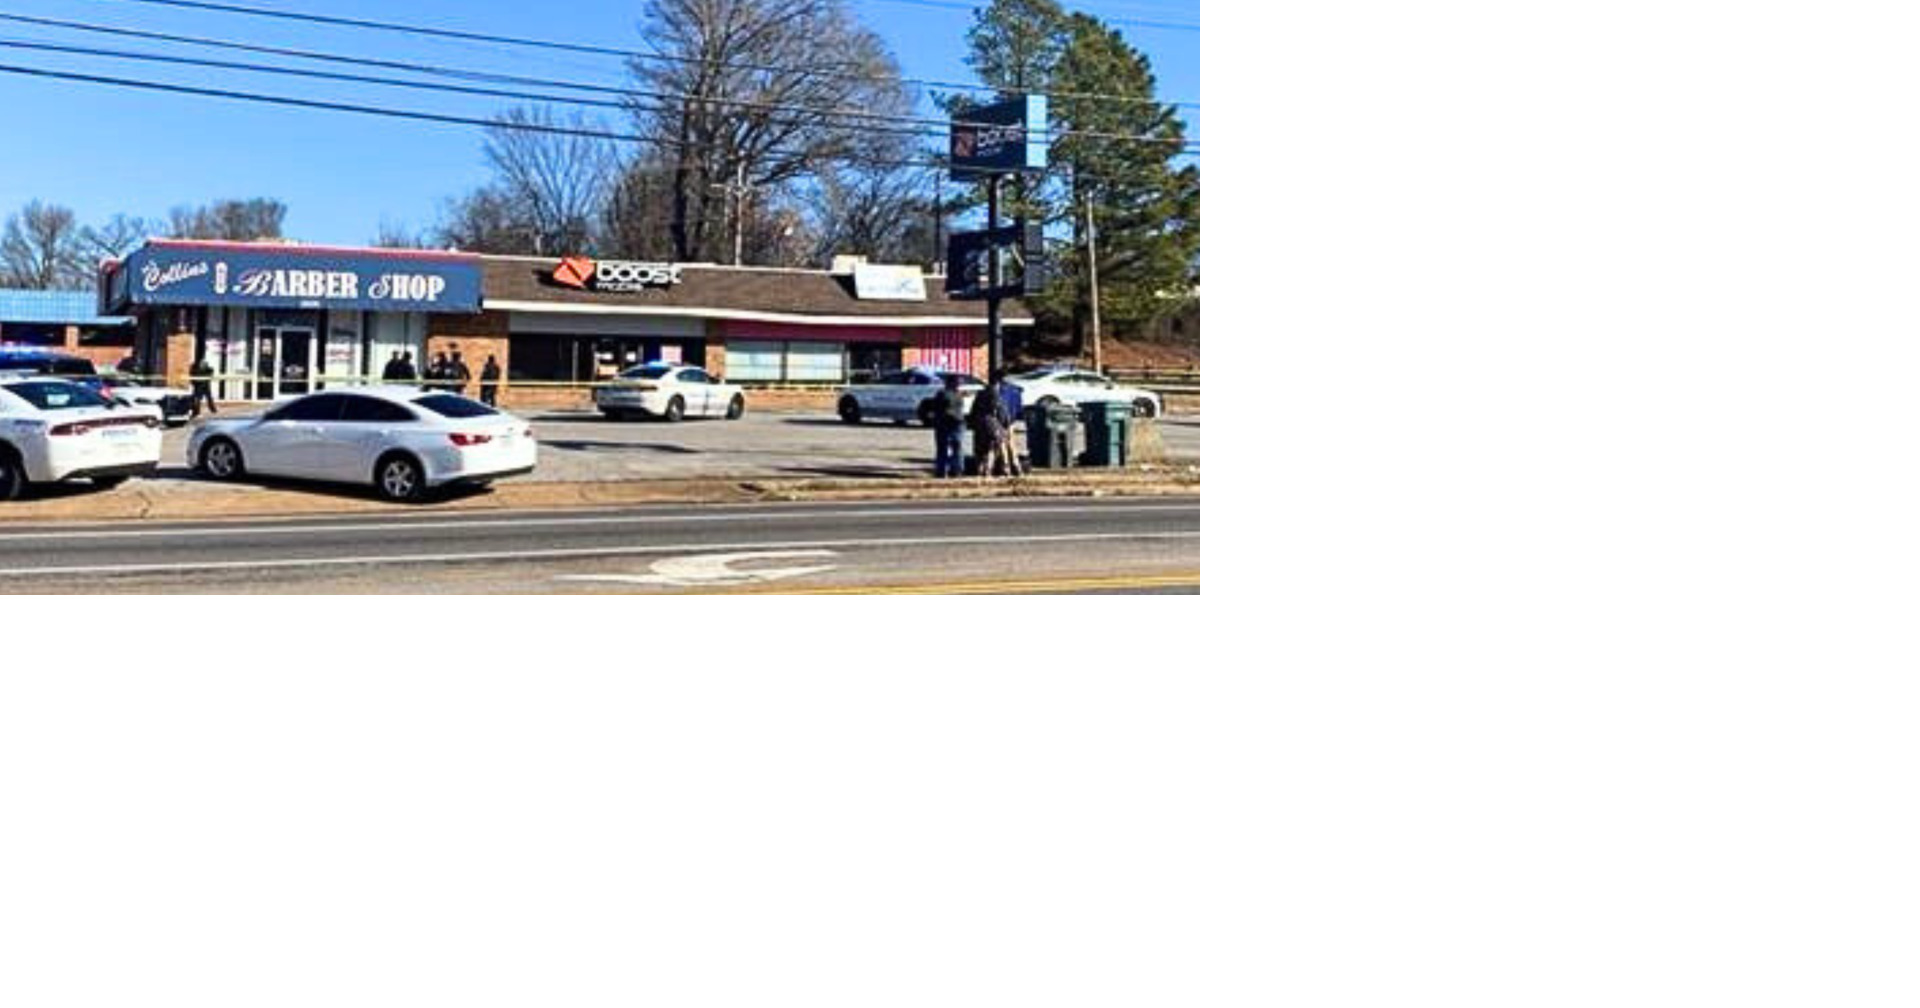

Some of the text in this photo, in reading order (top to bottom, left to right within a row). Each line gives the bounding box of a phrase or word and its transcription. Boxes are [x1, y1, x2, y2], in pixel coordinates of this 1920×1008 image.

[142, 262, 209, 292] Collins
[232, 269, 445, 301] BARBER SHOP
[596, 260, 681, 284] boost
